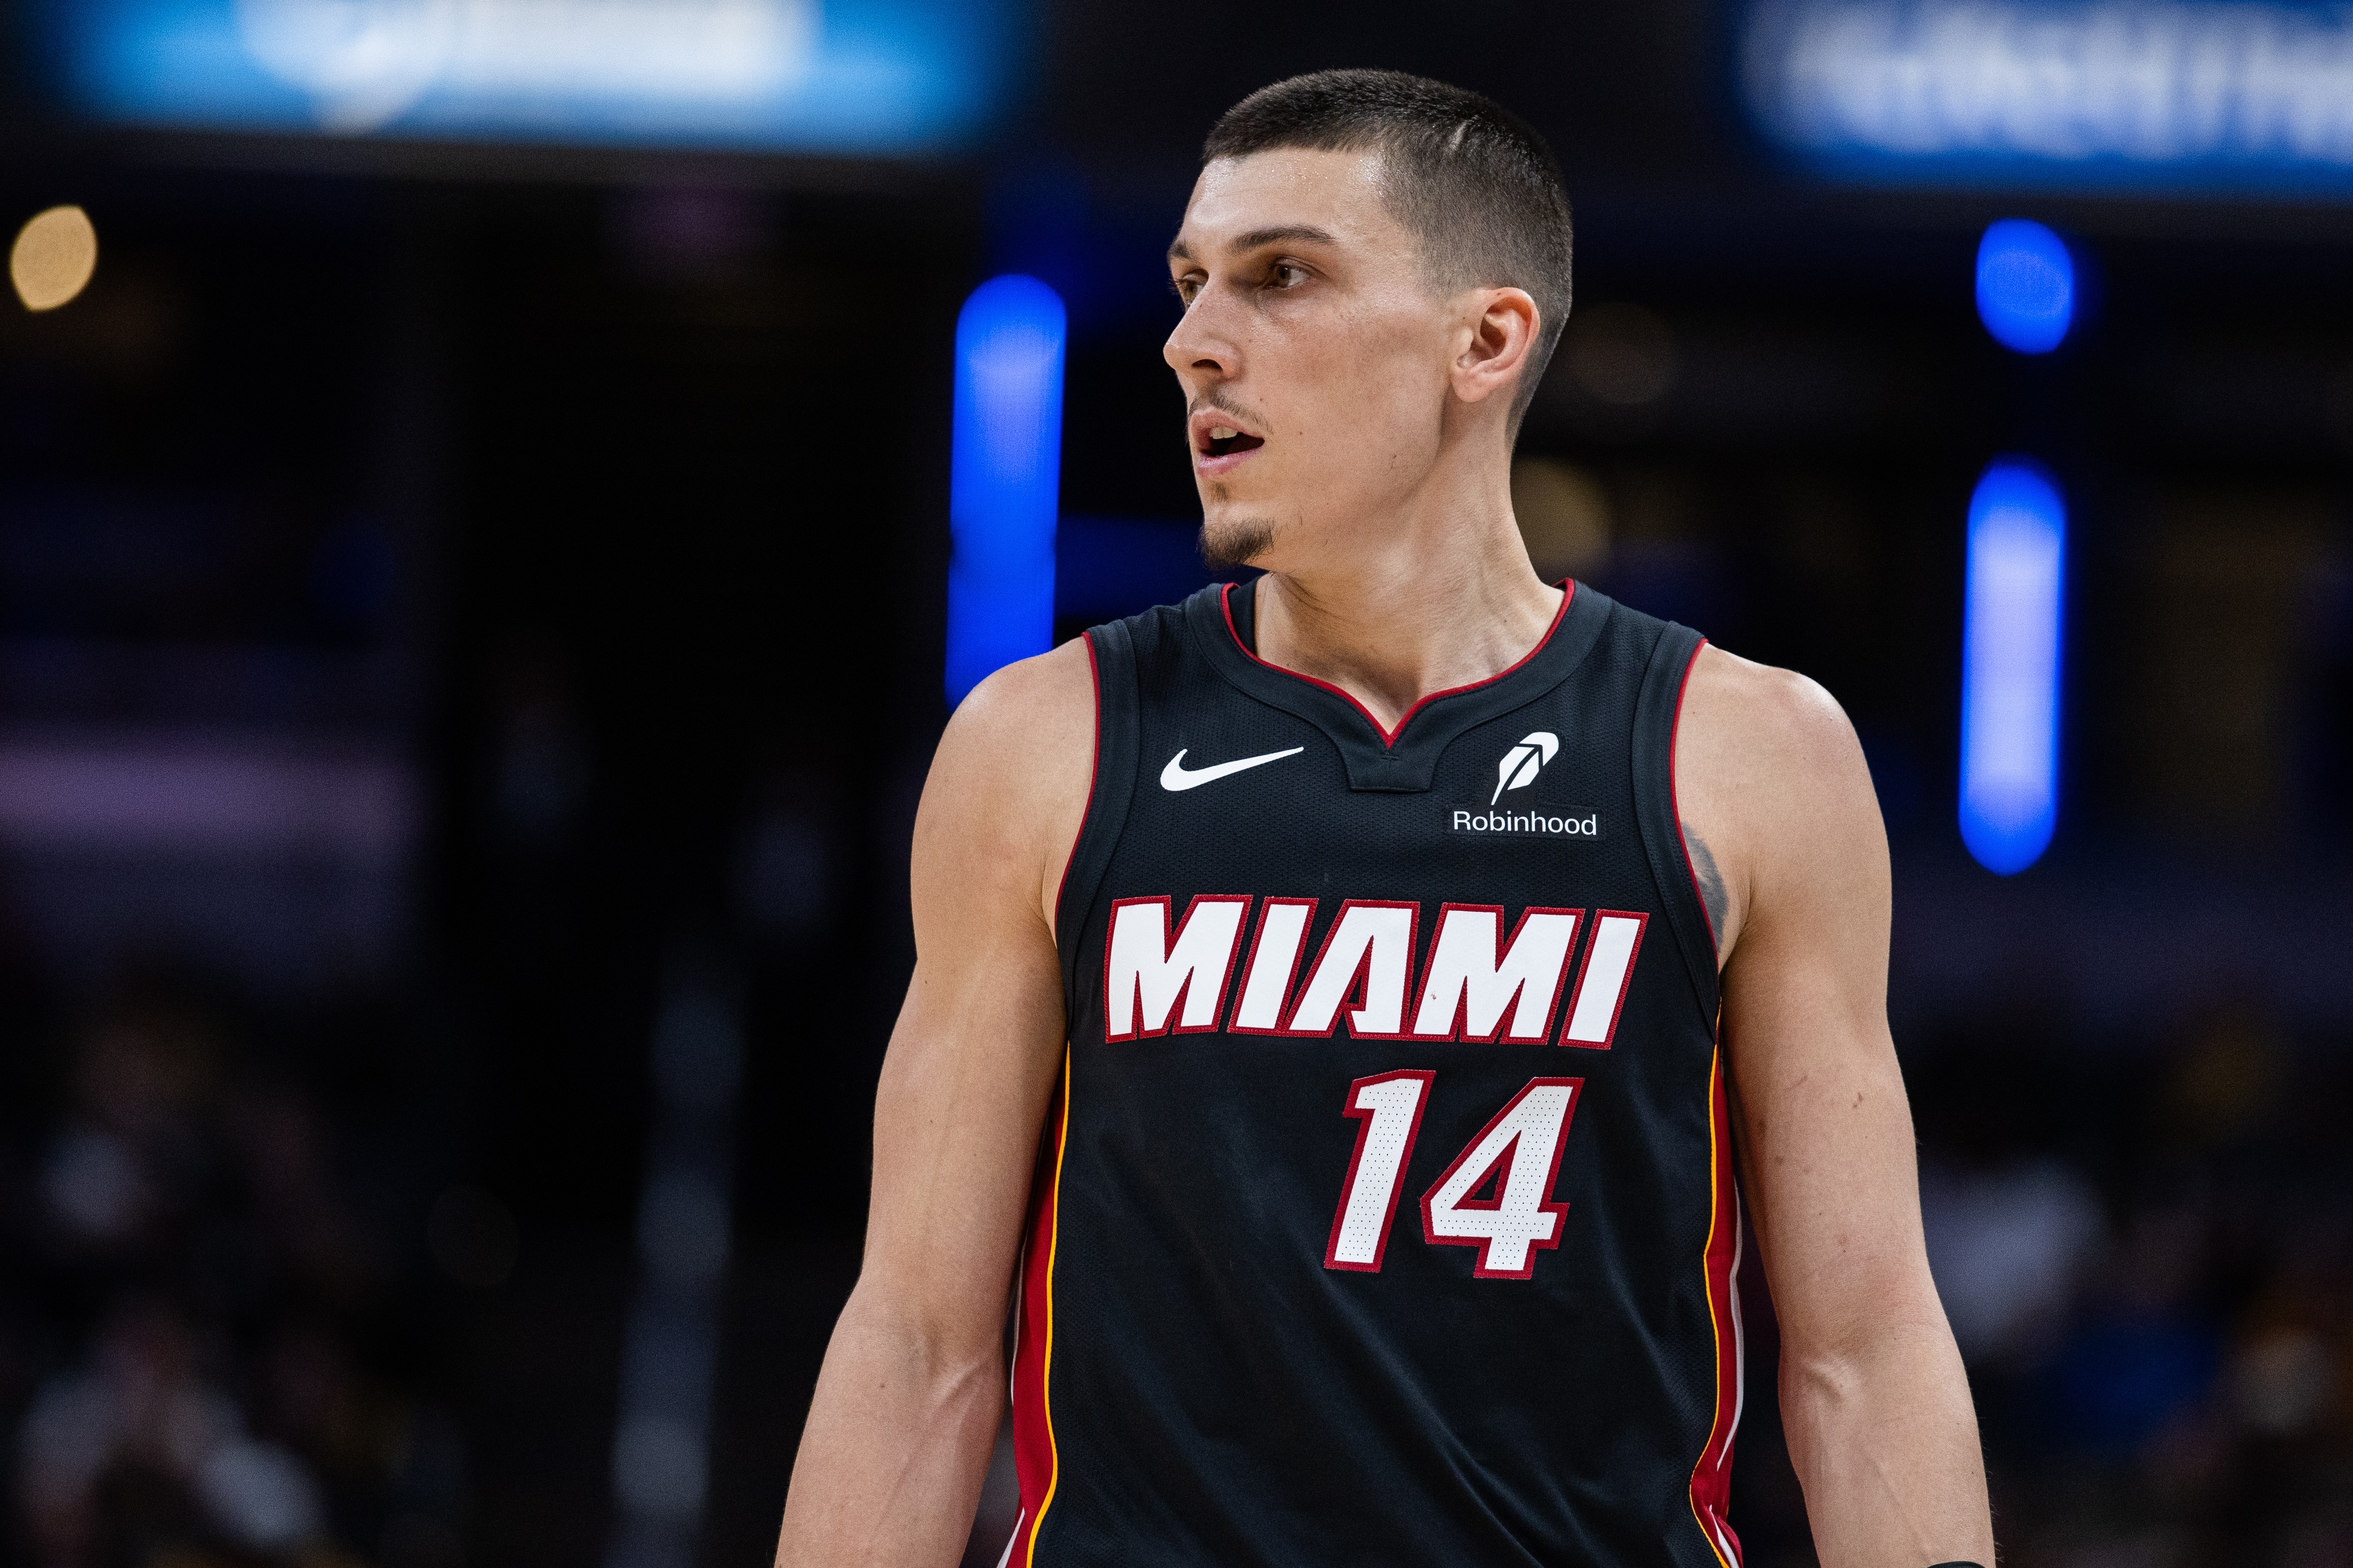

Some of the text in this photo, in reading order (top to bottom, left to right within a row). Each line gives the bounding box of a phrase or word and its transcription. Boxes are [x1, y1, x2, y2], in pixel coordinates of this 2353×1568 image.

[1453, 810, 1597, 835] Robinhood
[1105, 894, 1650, 1050] MIAMI
[1324, 1069, 1585, 1279] 14
